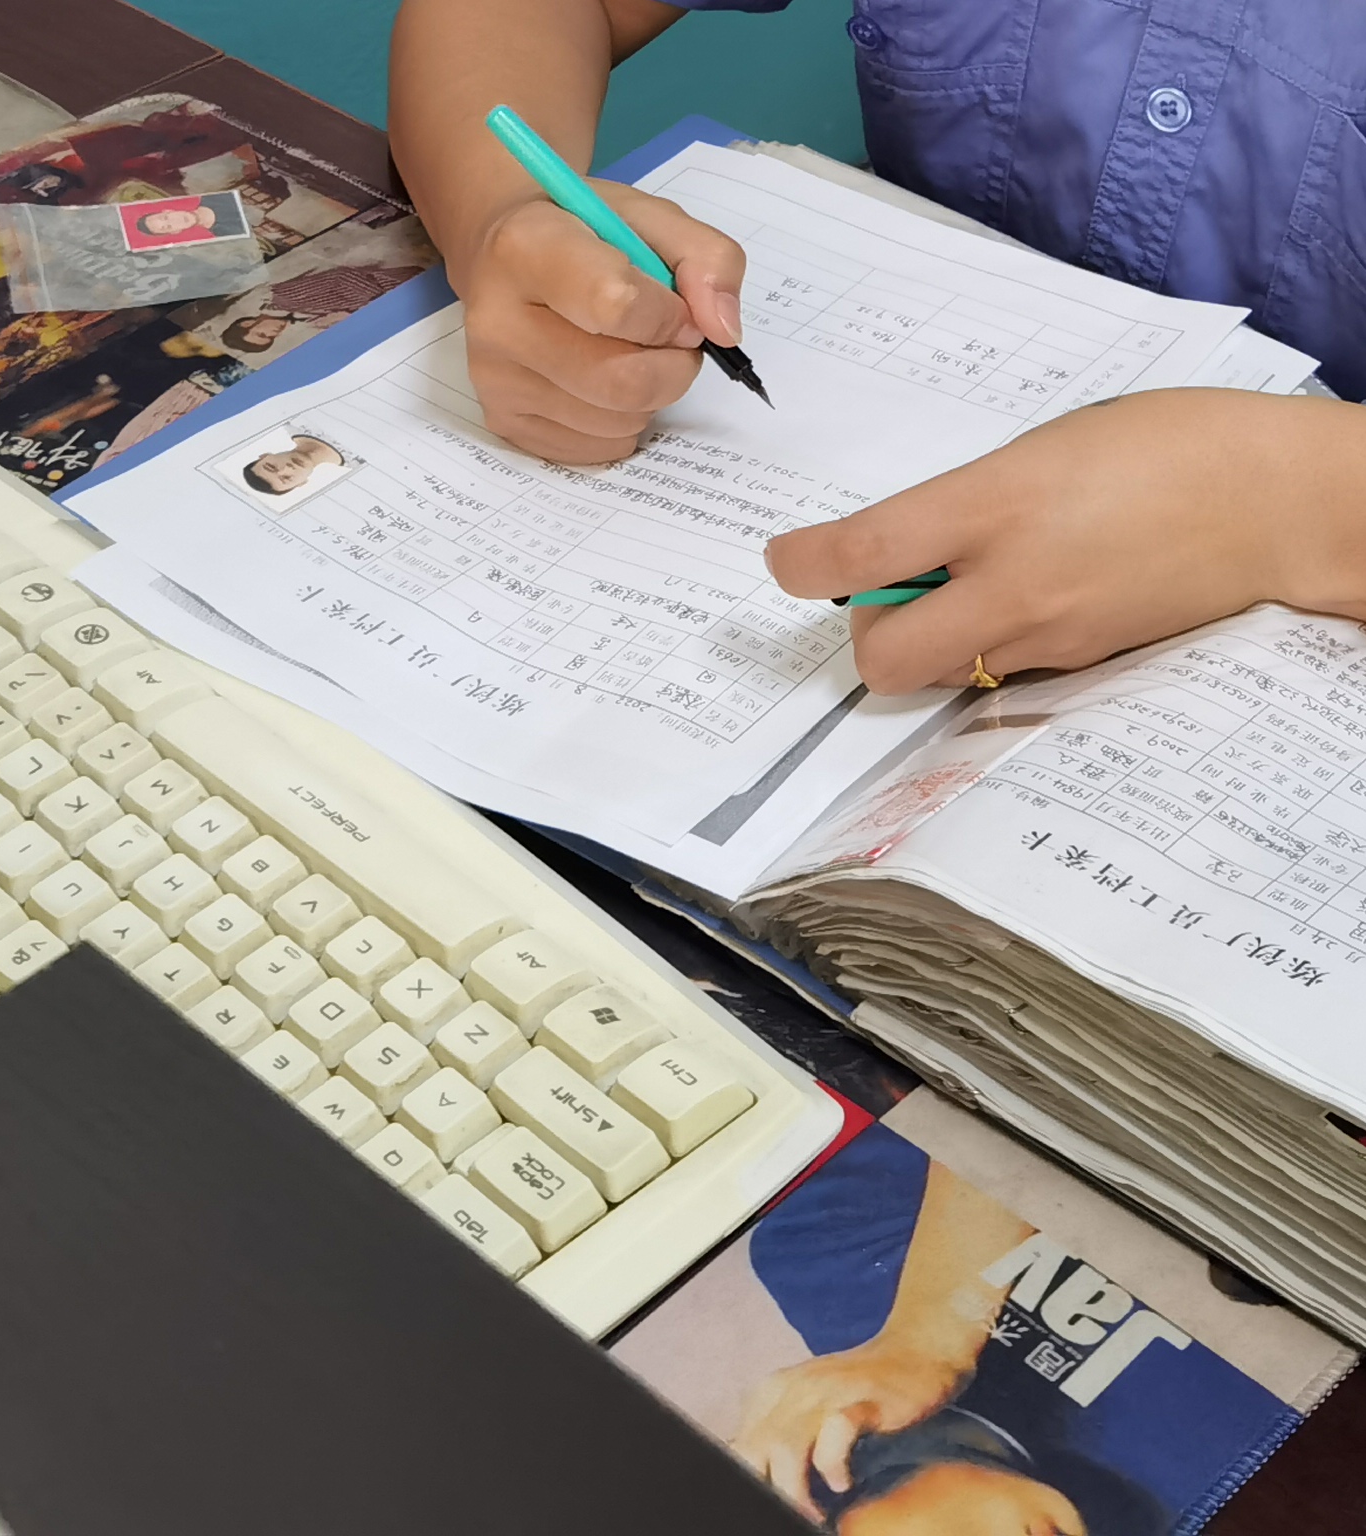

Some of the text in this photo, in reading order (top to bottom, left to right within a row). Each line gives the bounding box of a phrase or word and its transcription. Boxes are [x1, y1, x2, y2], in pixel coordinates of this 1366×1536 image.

[298, 586, 527, 716] 炼铁厂员工档案卡
[136, 669, 162, 685] Alt
[1265, 713, 1352, 762] 身份证号码
[28, 756, 43, 776] L
[1245, 730, 1338, 782] 固定电话
[1218, 746, 1318, 801] 联系方式
[150, 779, 174, 796] M
[1194, 763, 1297, 819] 毕业时间
[64, 795, 90, 814] K
[1119, 776, 1193, 822] 政治面貌
[288, 786, 371, 843] PERFECT
[1093, 794, 1171, 843] 出生年月
[199, 819, 221, 834] N
[118, 839, 134, 848] J
[250, 859, 270, 874] B
[1312, 847, 1349, 876] 专业
[162, 875, 184, 892] H
[1289, 864, 1331, 894] 职称
[62, 882, 83, 898] U
[1267, 881, 1309, 912] 血型
[300, 900, 318, 914] V
[1022, 831, 1325, 987] 炼铁厂员工档案卡
[112, 927, 130, 940] Y
[216, 917, 234, 933] G
[29, 941, 48, 952] 7
[355, 939, 373, 955] C
[1311, 926, 1343, 950] 24
[267, 962, 287, 974] F
[516, 951, 547, 969] Alt
[163, 969, 181, 982] T
[406, 978, 434, 1000] X
[215, 1008, 236, 1025] R
[319, 1001, 346, 1022] D
[463, 1023, 490, 1045] Z
[272, 1054, 291, 1071] E
[377, 1046, 401, 1066] S
[660, 1059, 698, 1086] Ctrl
[438, 1091, 457, 1107] A
[550, 1086, 599, 1124] Shift
[323, 1103, 346, 1121] W
[382, 1149, 404, 1167] Q
[512, 1162, 555, 1201] Caps
[521, 1152, 566, 1191] Lock
[453, 1209, 488, 1244] Tab
